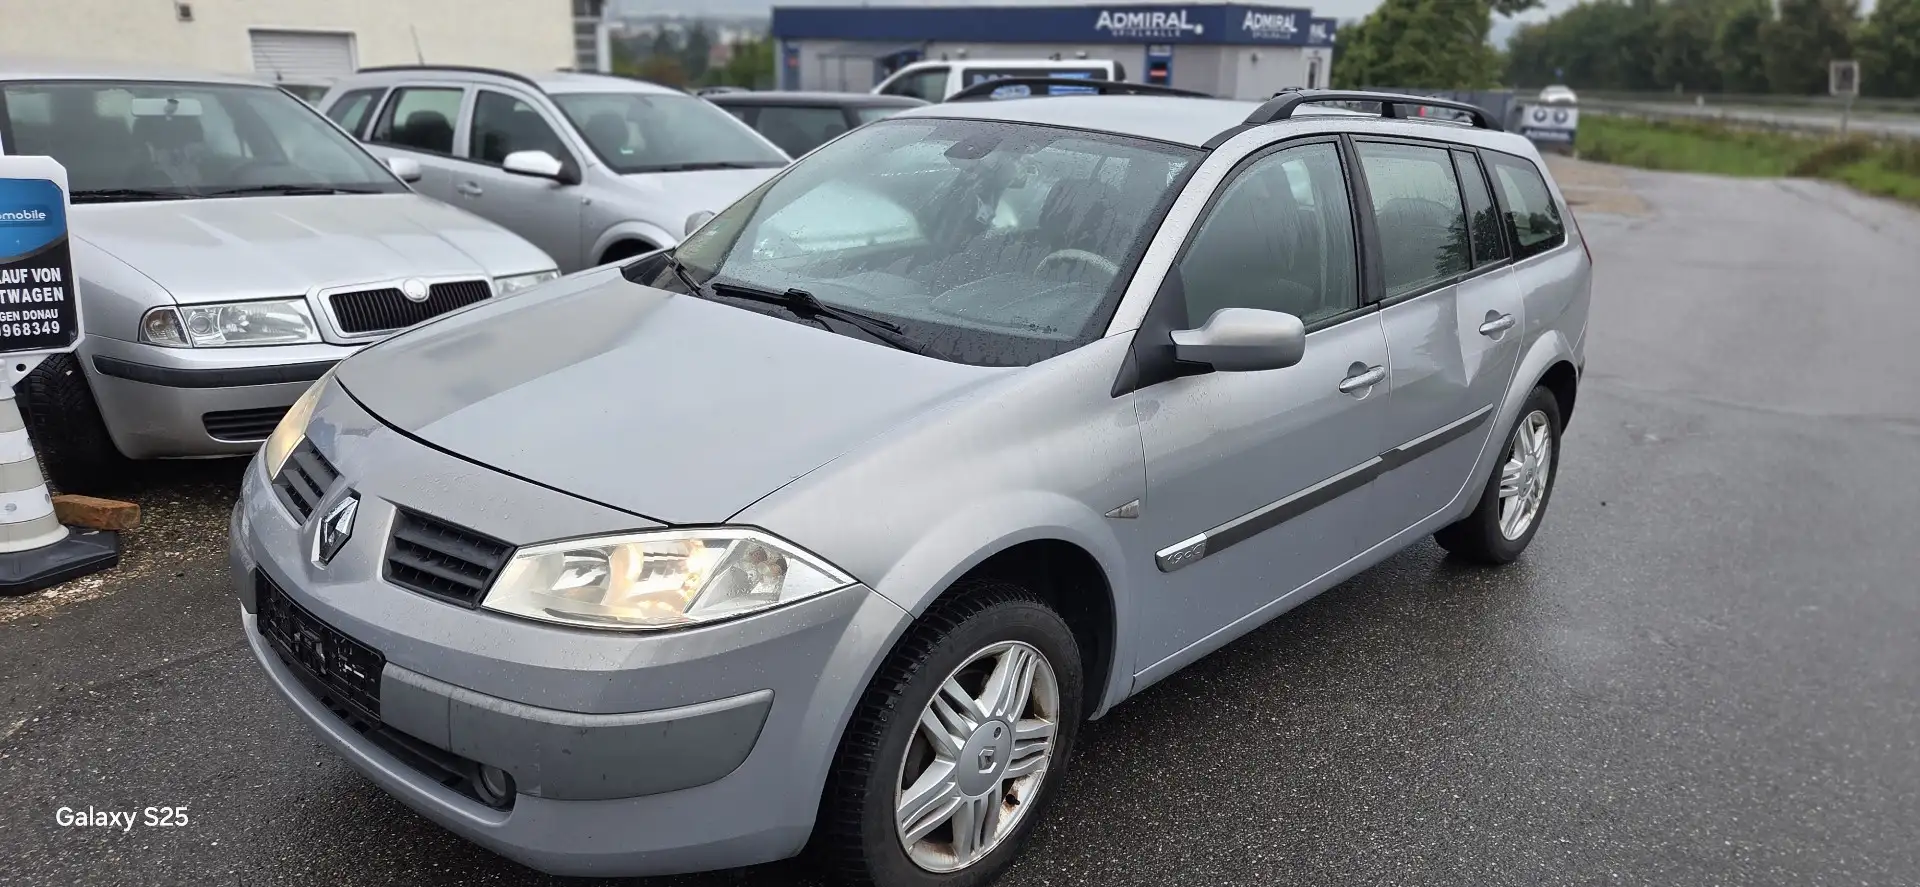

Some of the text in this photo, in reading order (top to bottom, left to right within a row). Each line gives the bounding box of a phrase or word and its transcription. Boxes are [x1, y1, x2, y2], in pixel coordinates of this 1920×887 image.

[1242, 10, 1298, 33] ADMIRAL
[0, 267, 61, 285] AUF VON
[23, 308, 59, 321] DONAU
[0, 320, 60, 337] 968349
